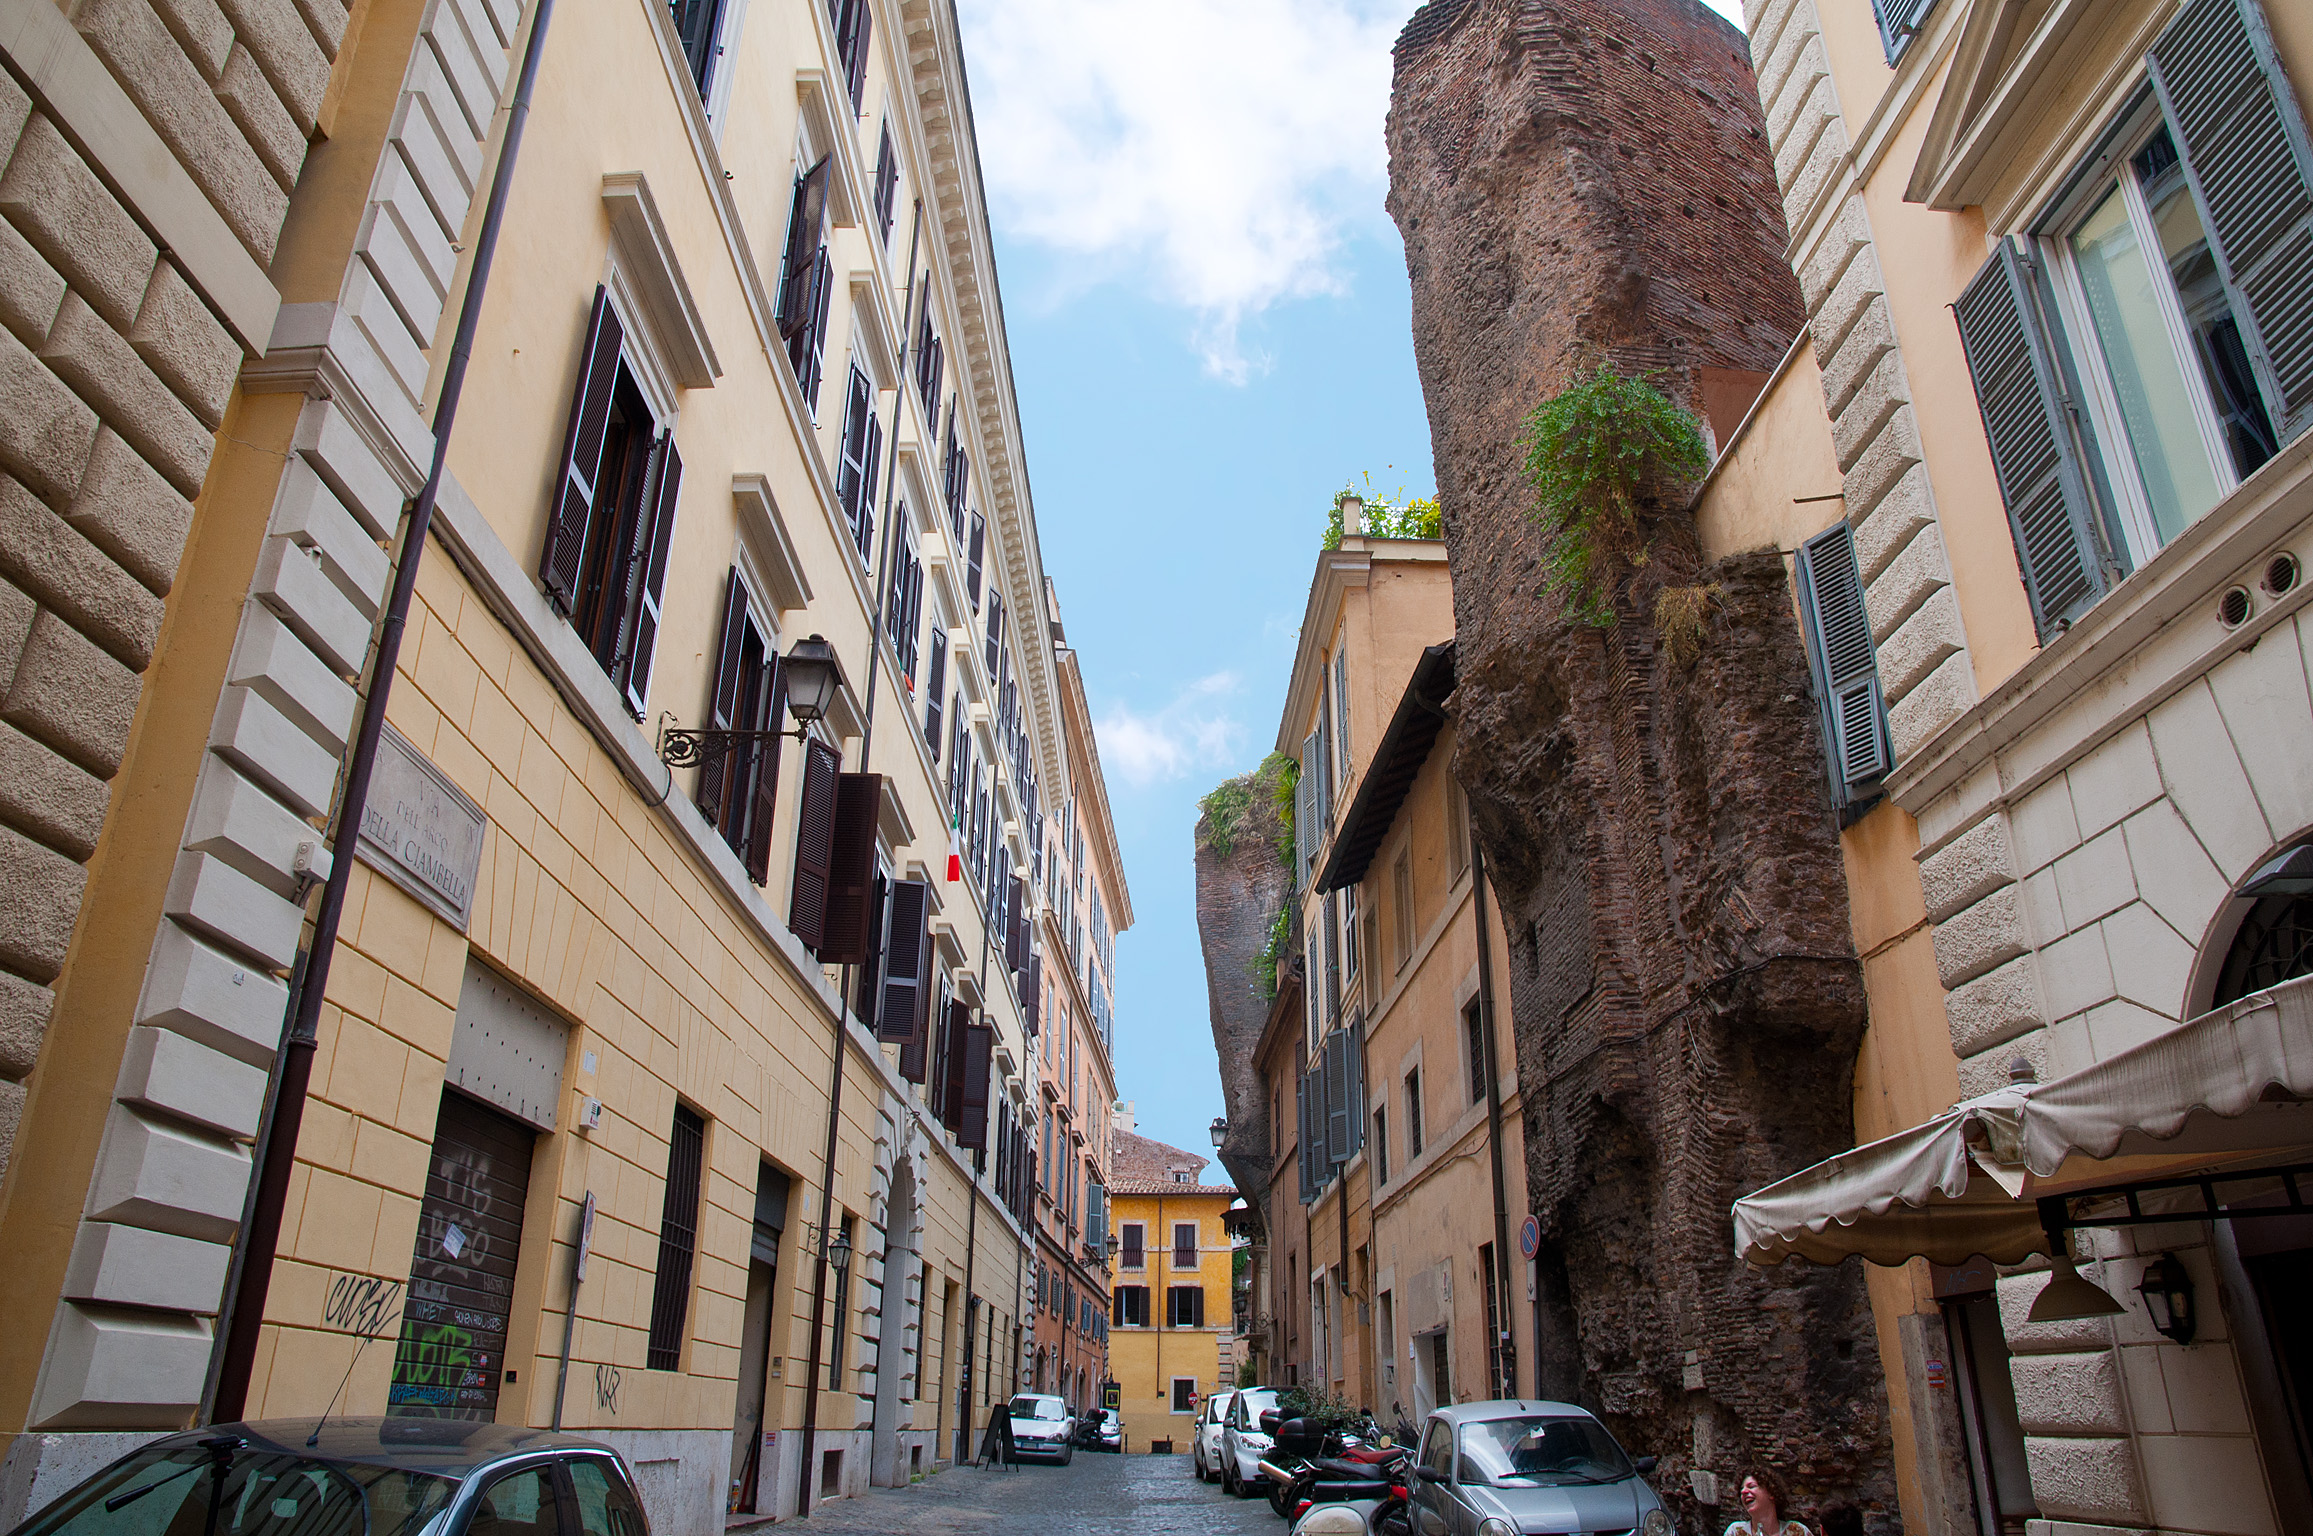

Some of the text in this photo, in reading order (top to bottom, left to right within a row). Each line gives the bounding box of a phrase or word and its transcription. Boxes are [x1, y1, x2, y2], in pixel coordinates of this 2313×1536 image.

[420, 780, 441, 818] VIA
[359, 804, 466, 906] DELLA CIAMBELLA
[424, 824, 448, 853] ARCO
